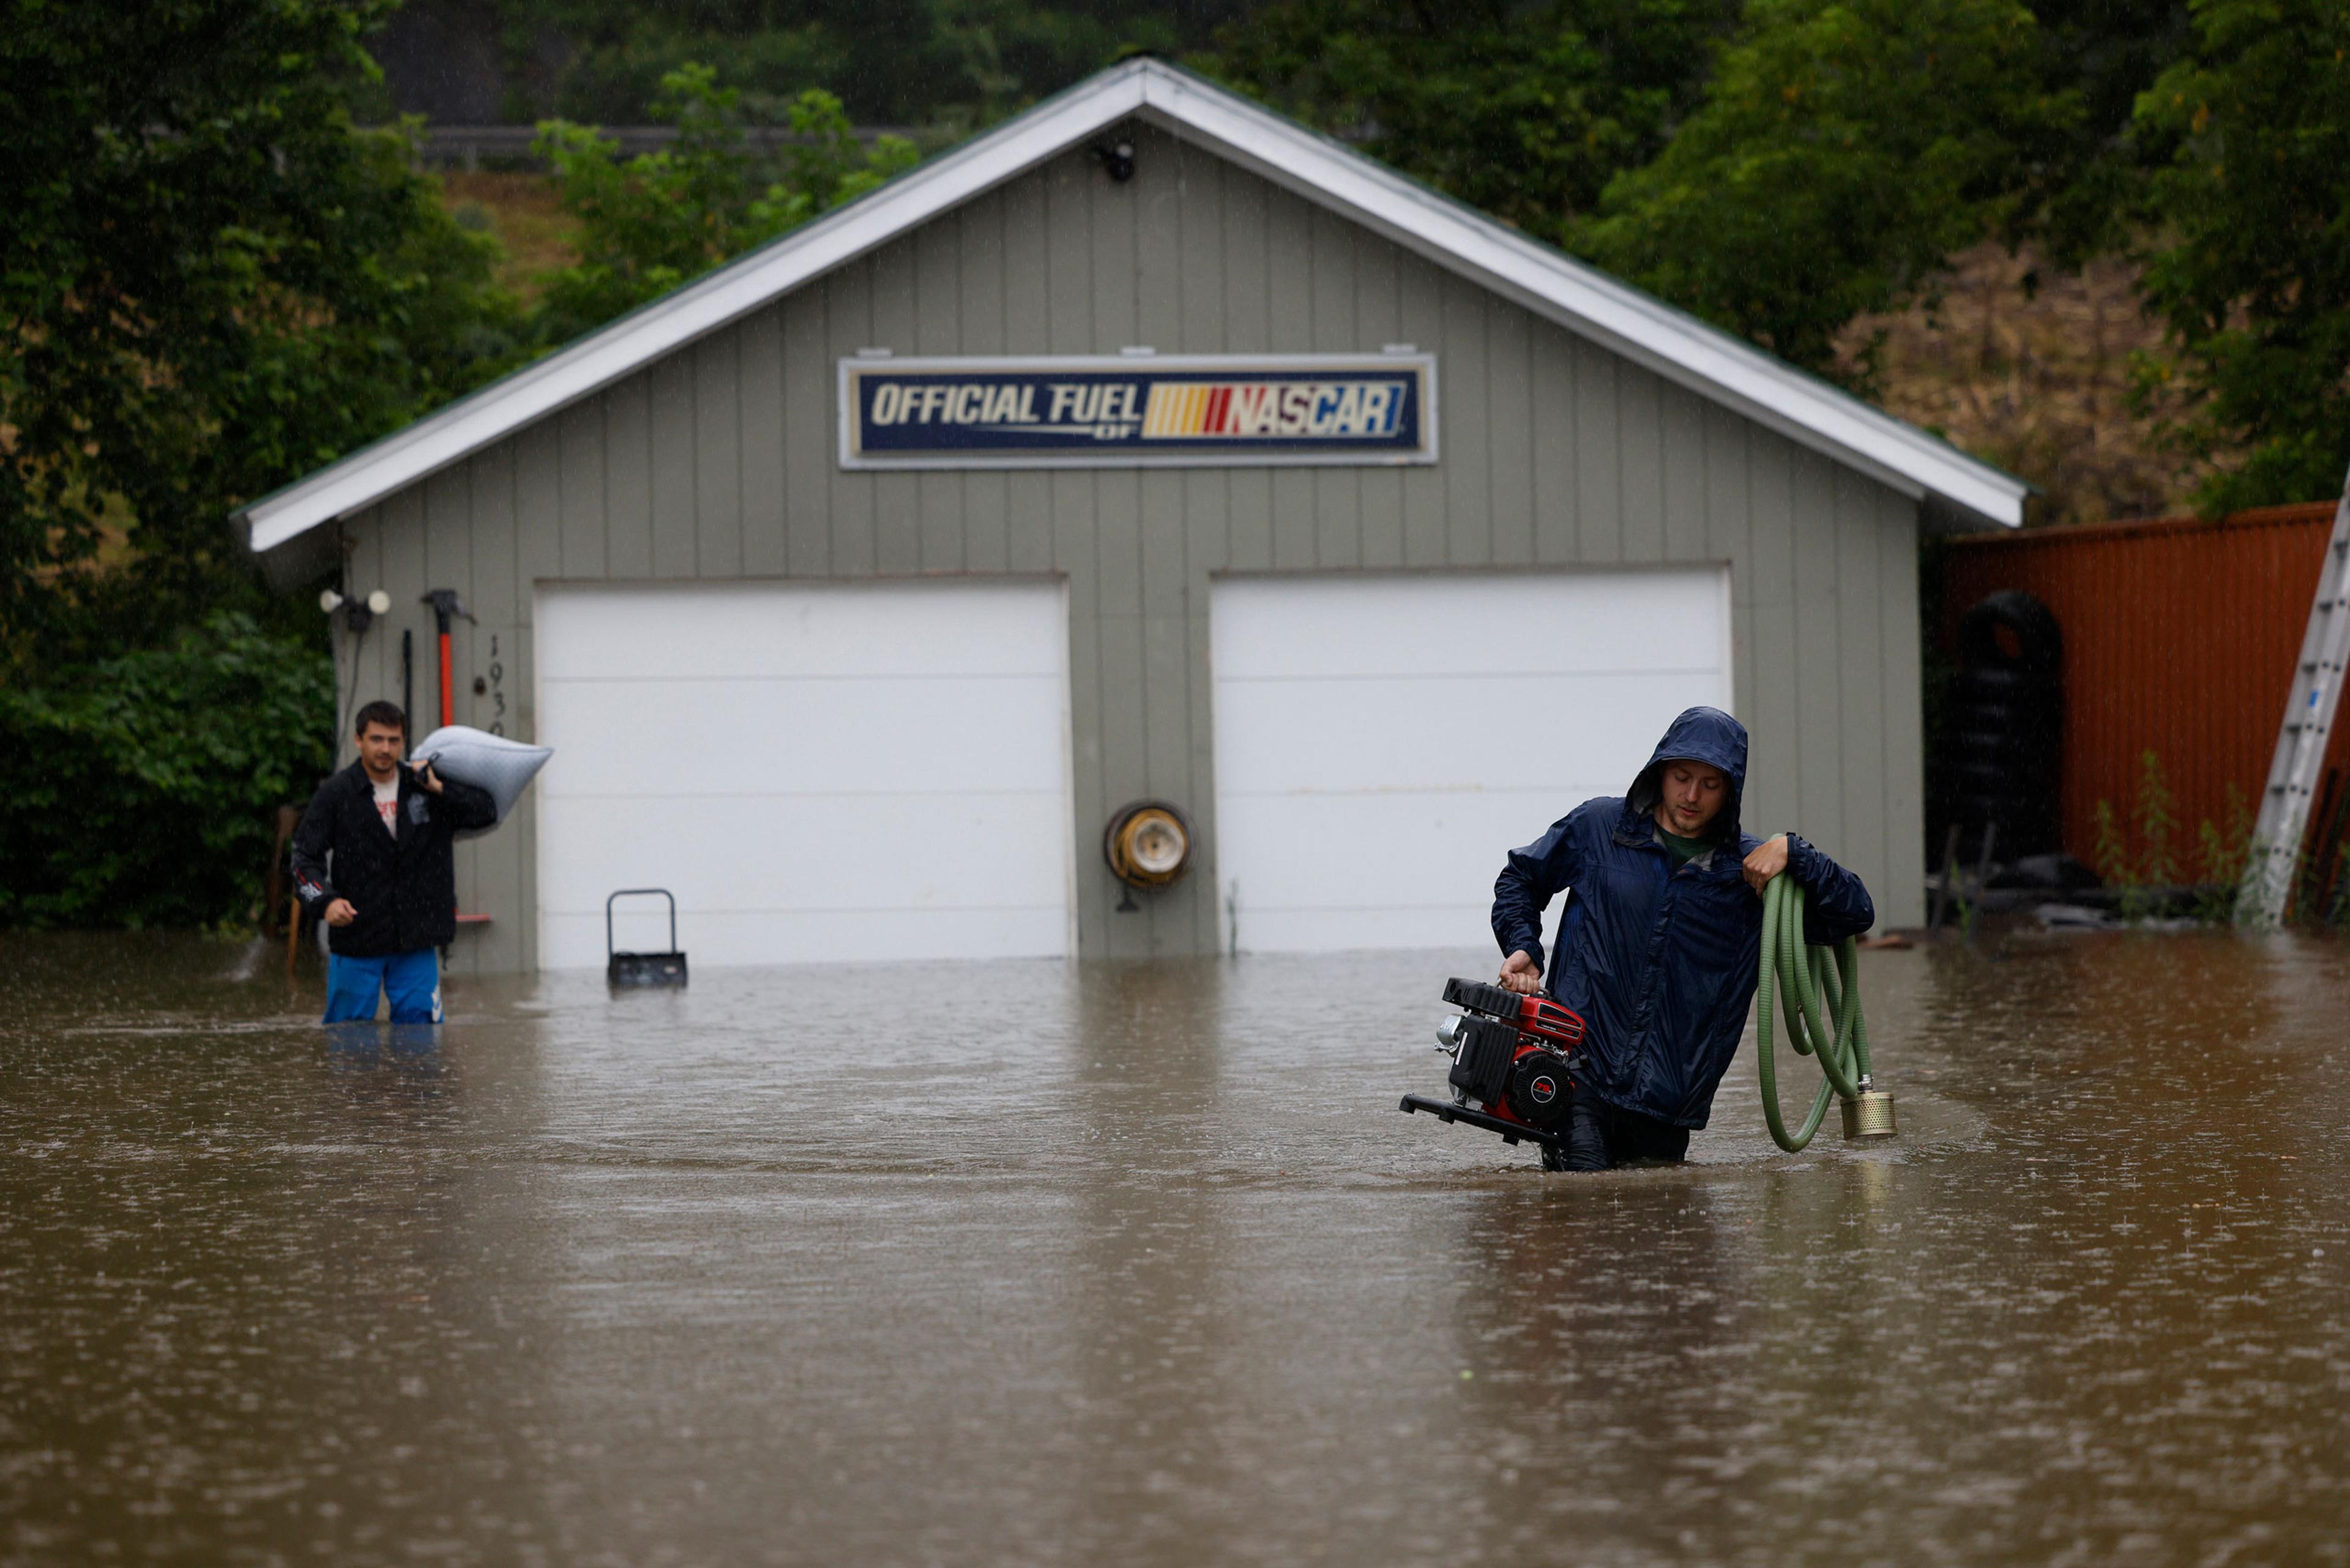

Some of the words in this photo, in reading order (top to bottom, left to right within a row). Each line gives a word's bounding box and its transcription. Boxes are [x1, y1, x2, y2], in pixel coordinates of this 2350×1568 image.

[871, 383, 1039, 425] OFFICIAL
[1047, 384, 1141, 422] FUEL
[1225, 384, 1392, 435] NASCAR
